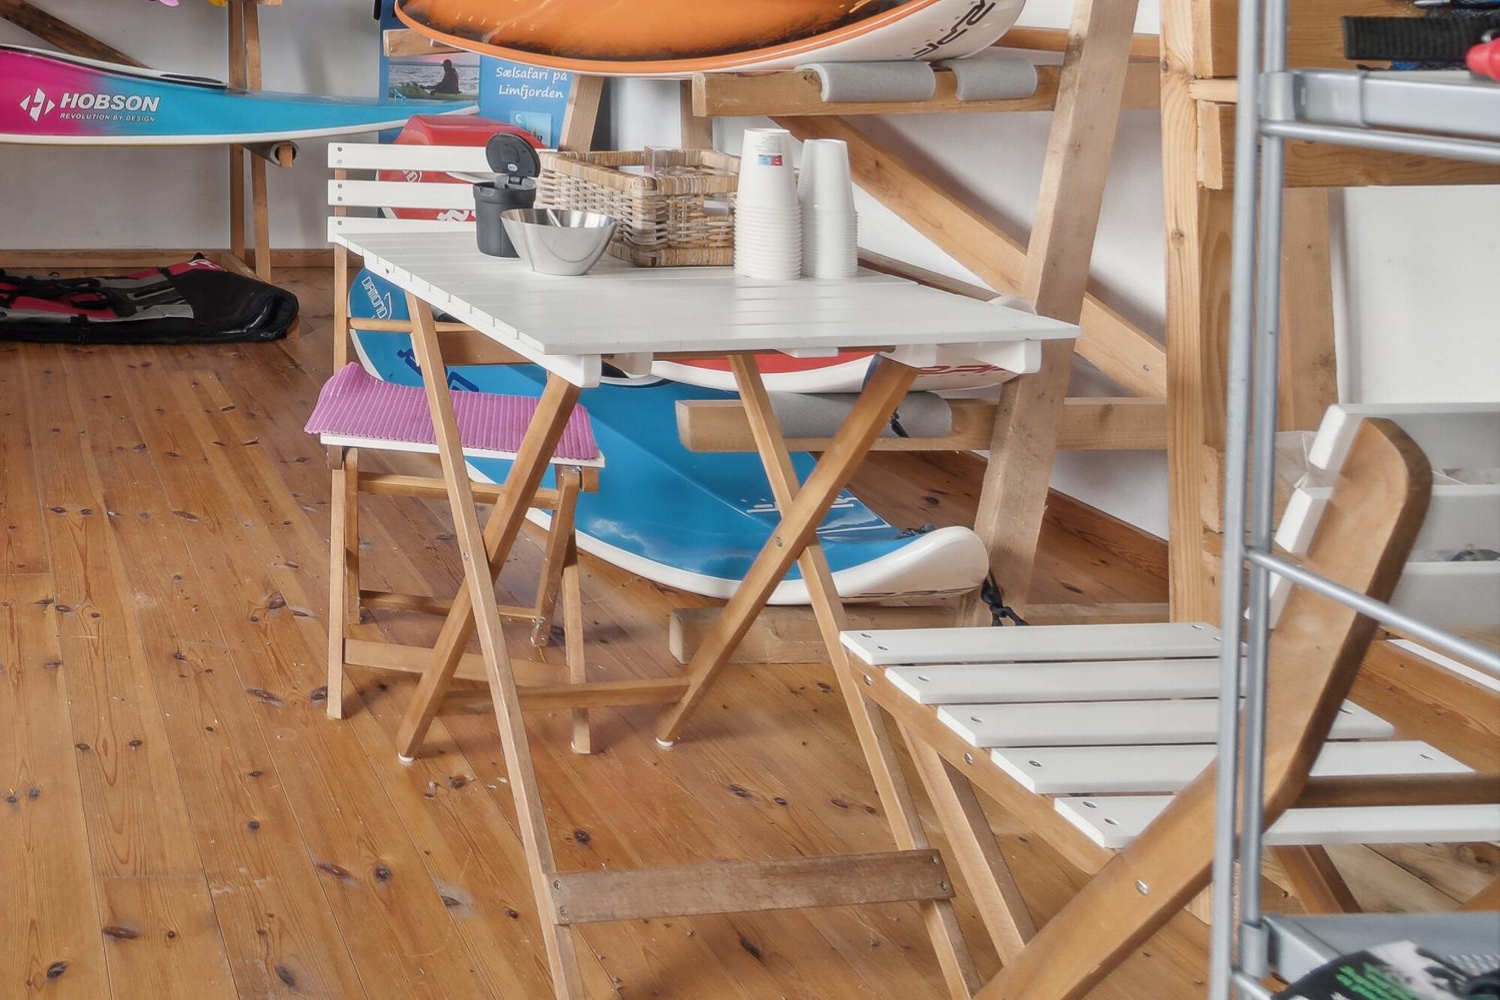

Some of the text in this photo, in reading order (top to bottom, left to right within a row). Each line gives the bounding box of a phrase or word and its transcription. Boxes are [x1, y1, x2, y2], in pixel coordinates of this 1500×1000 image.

[495, 66, 548, 80] Sælsafari
[498, 84, 564, 100] Limfjorden
[59, 92, 160, 112] HOBSON
[60, 113, 110, 121] REVOLUTION
